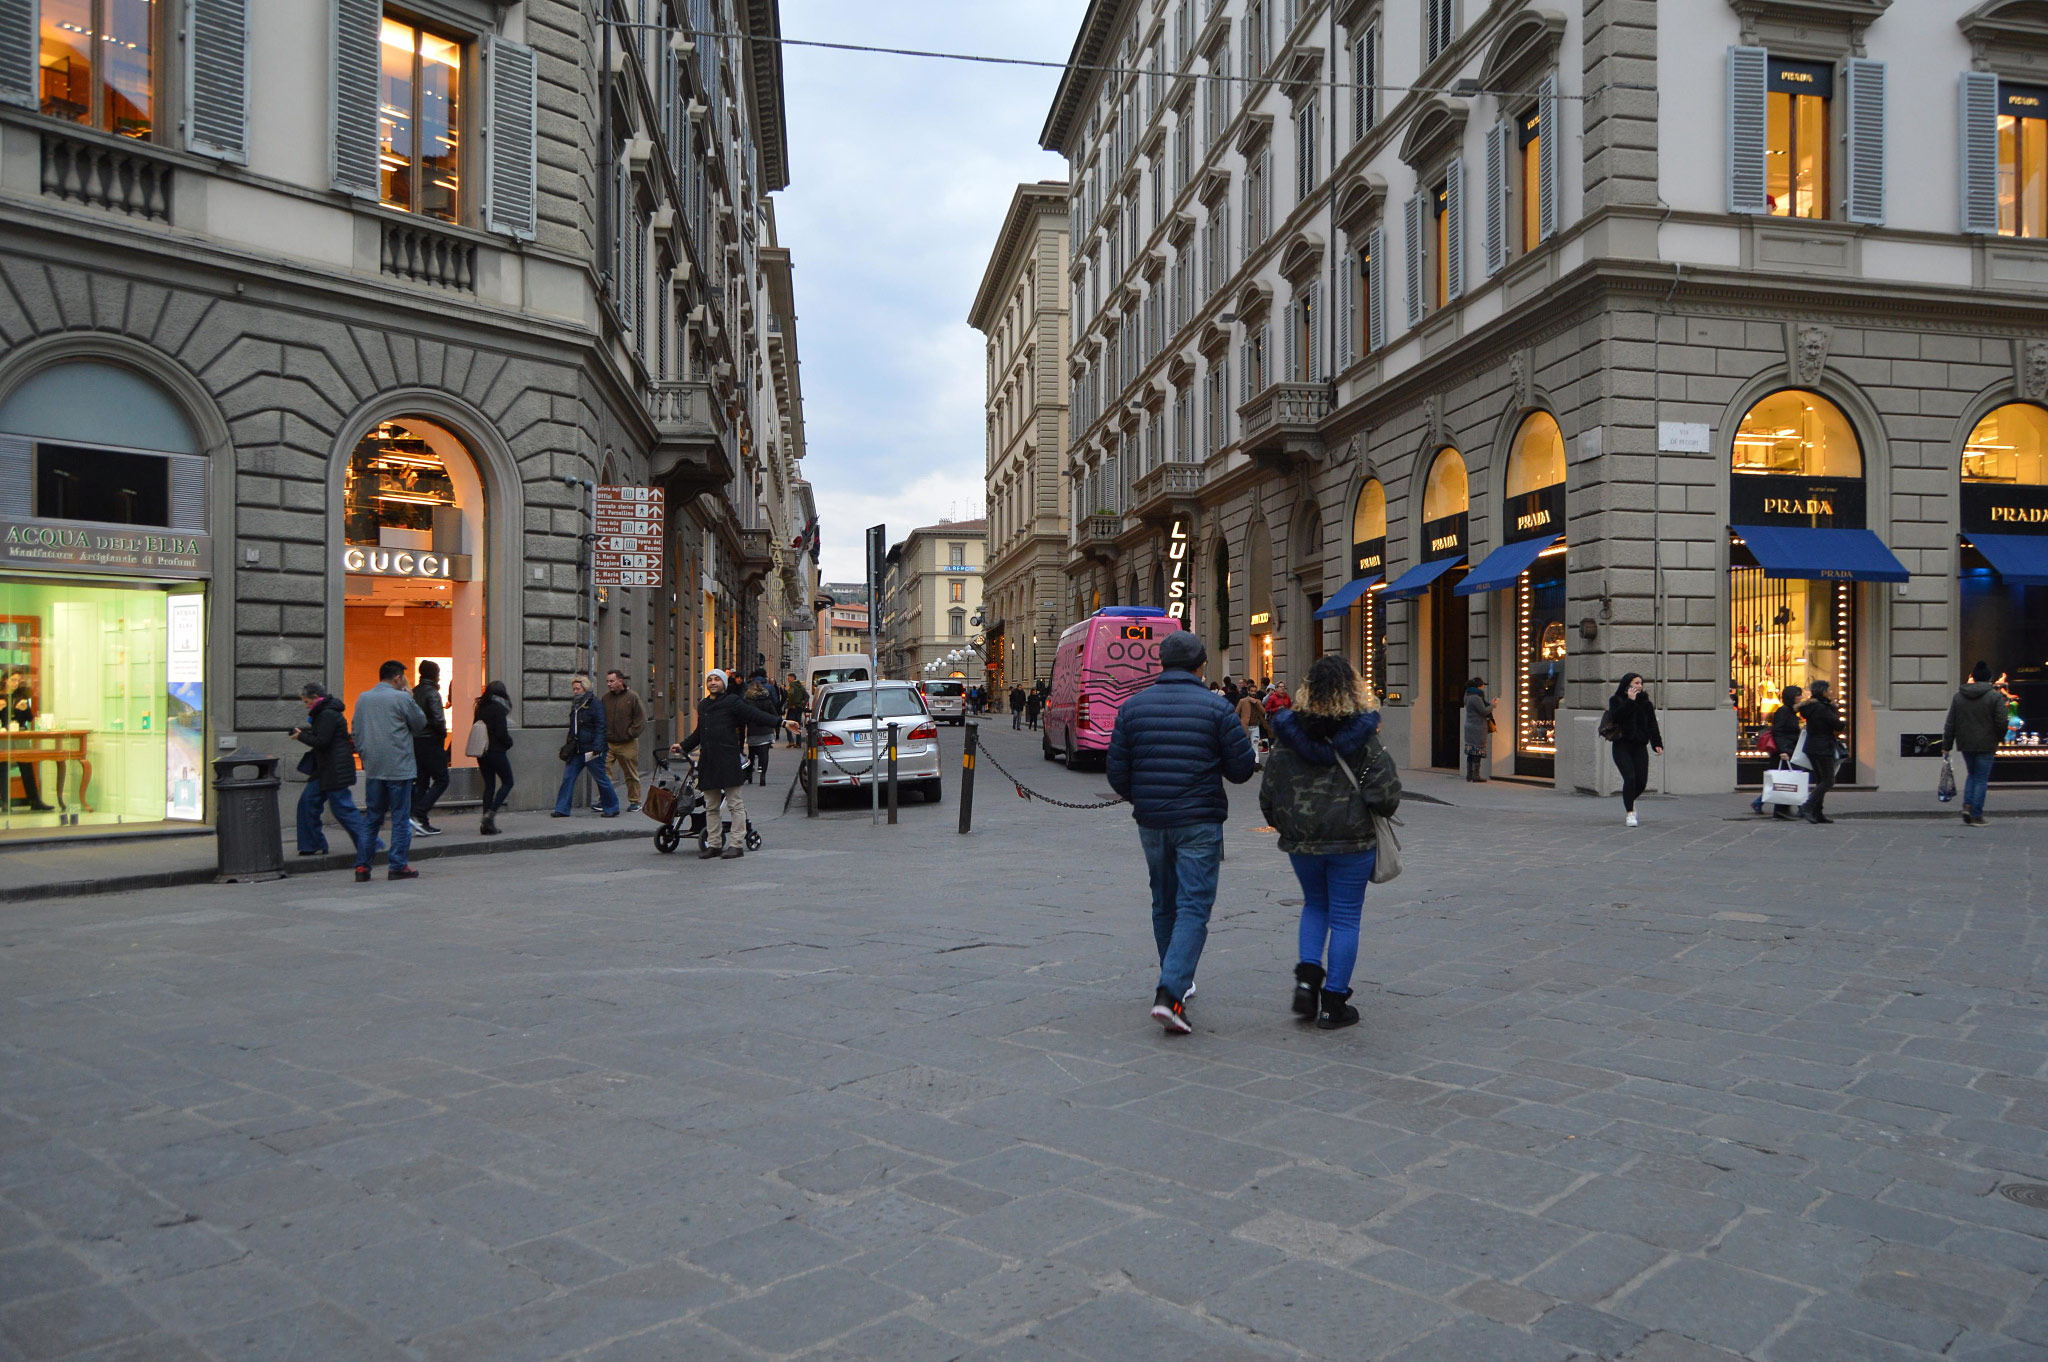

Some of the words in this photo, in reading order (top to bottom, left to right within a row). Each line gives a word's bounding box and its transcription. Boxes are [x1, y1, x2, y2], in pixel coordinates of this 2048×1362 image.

[1764, 498, 1833, 515] PRADA
[1991, 506, 2048, 522] PRADA
[1517, 509, 1551, 530] PRADA
[6, 526, 92, 549] ACQUA
[1432, 534, 1458, 551] PRADA
[9, 546, 74, 560] Manifattura
[80, 551, 138, 565] Artigianale
[142, 556, 153, 565] di
[158, 556, 197, 567] Profumi
[344, 549, 449, 577] GUCCI
[1168, 521, 1187, 619] LUISA
[1821, 570, 1853, 578] PRADA
[1126, 625, 1147, 640] C1
